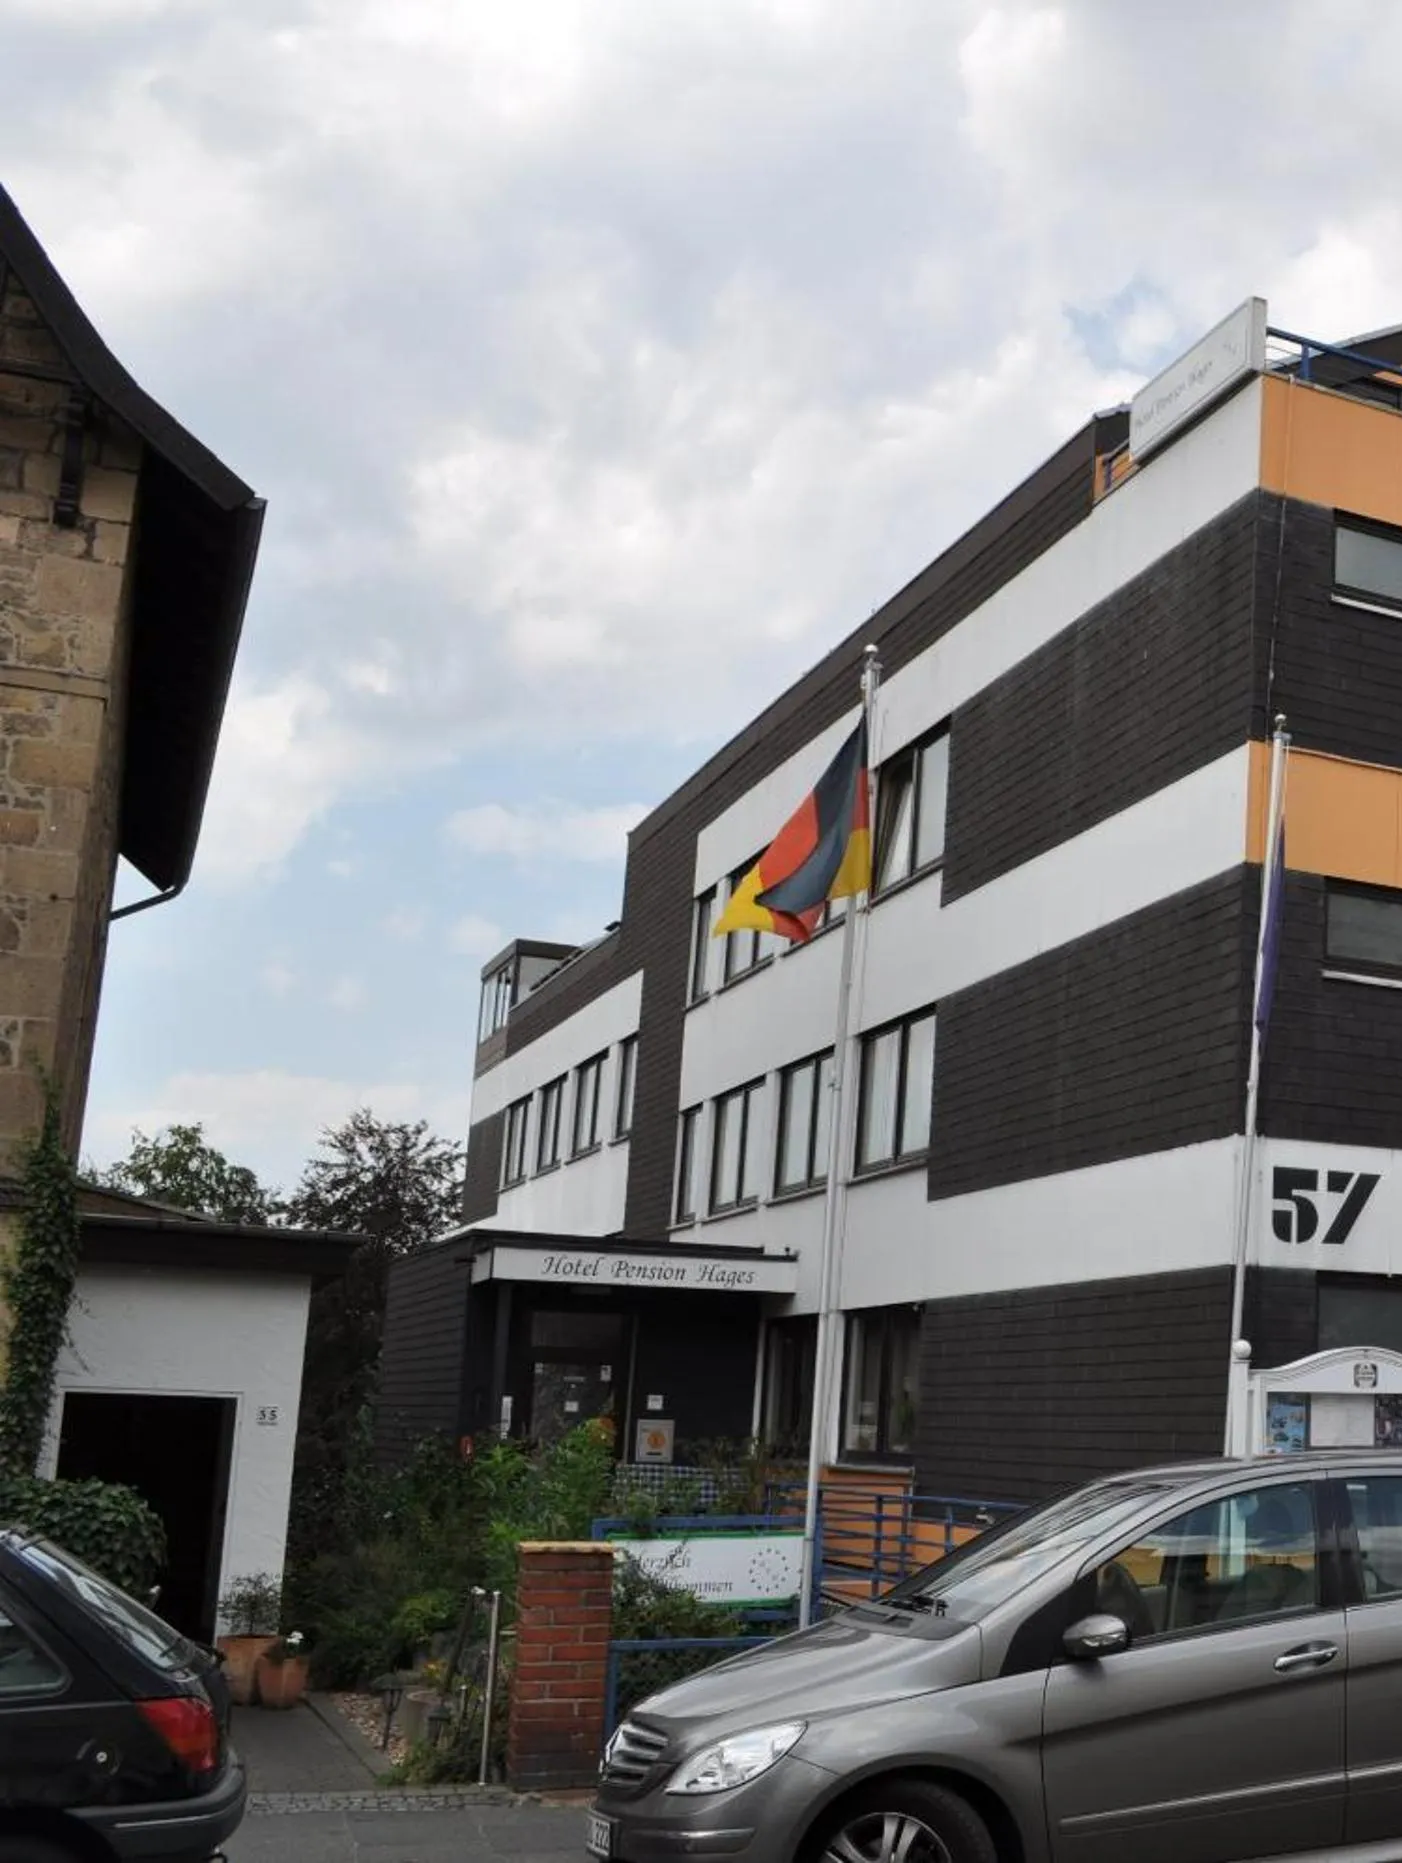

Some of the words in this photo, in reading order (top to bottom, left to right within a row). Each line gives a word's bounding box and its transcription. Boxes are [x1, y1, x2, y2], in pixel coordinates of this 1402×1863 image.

[1272, 1166, 1382, 1244] 57
[541, 1256, 604, 1278] Hotel
[611, 1259, 687, 1282] Pension
[697, 1264, 755, 1287] Hages
